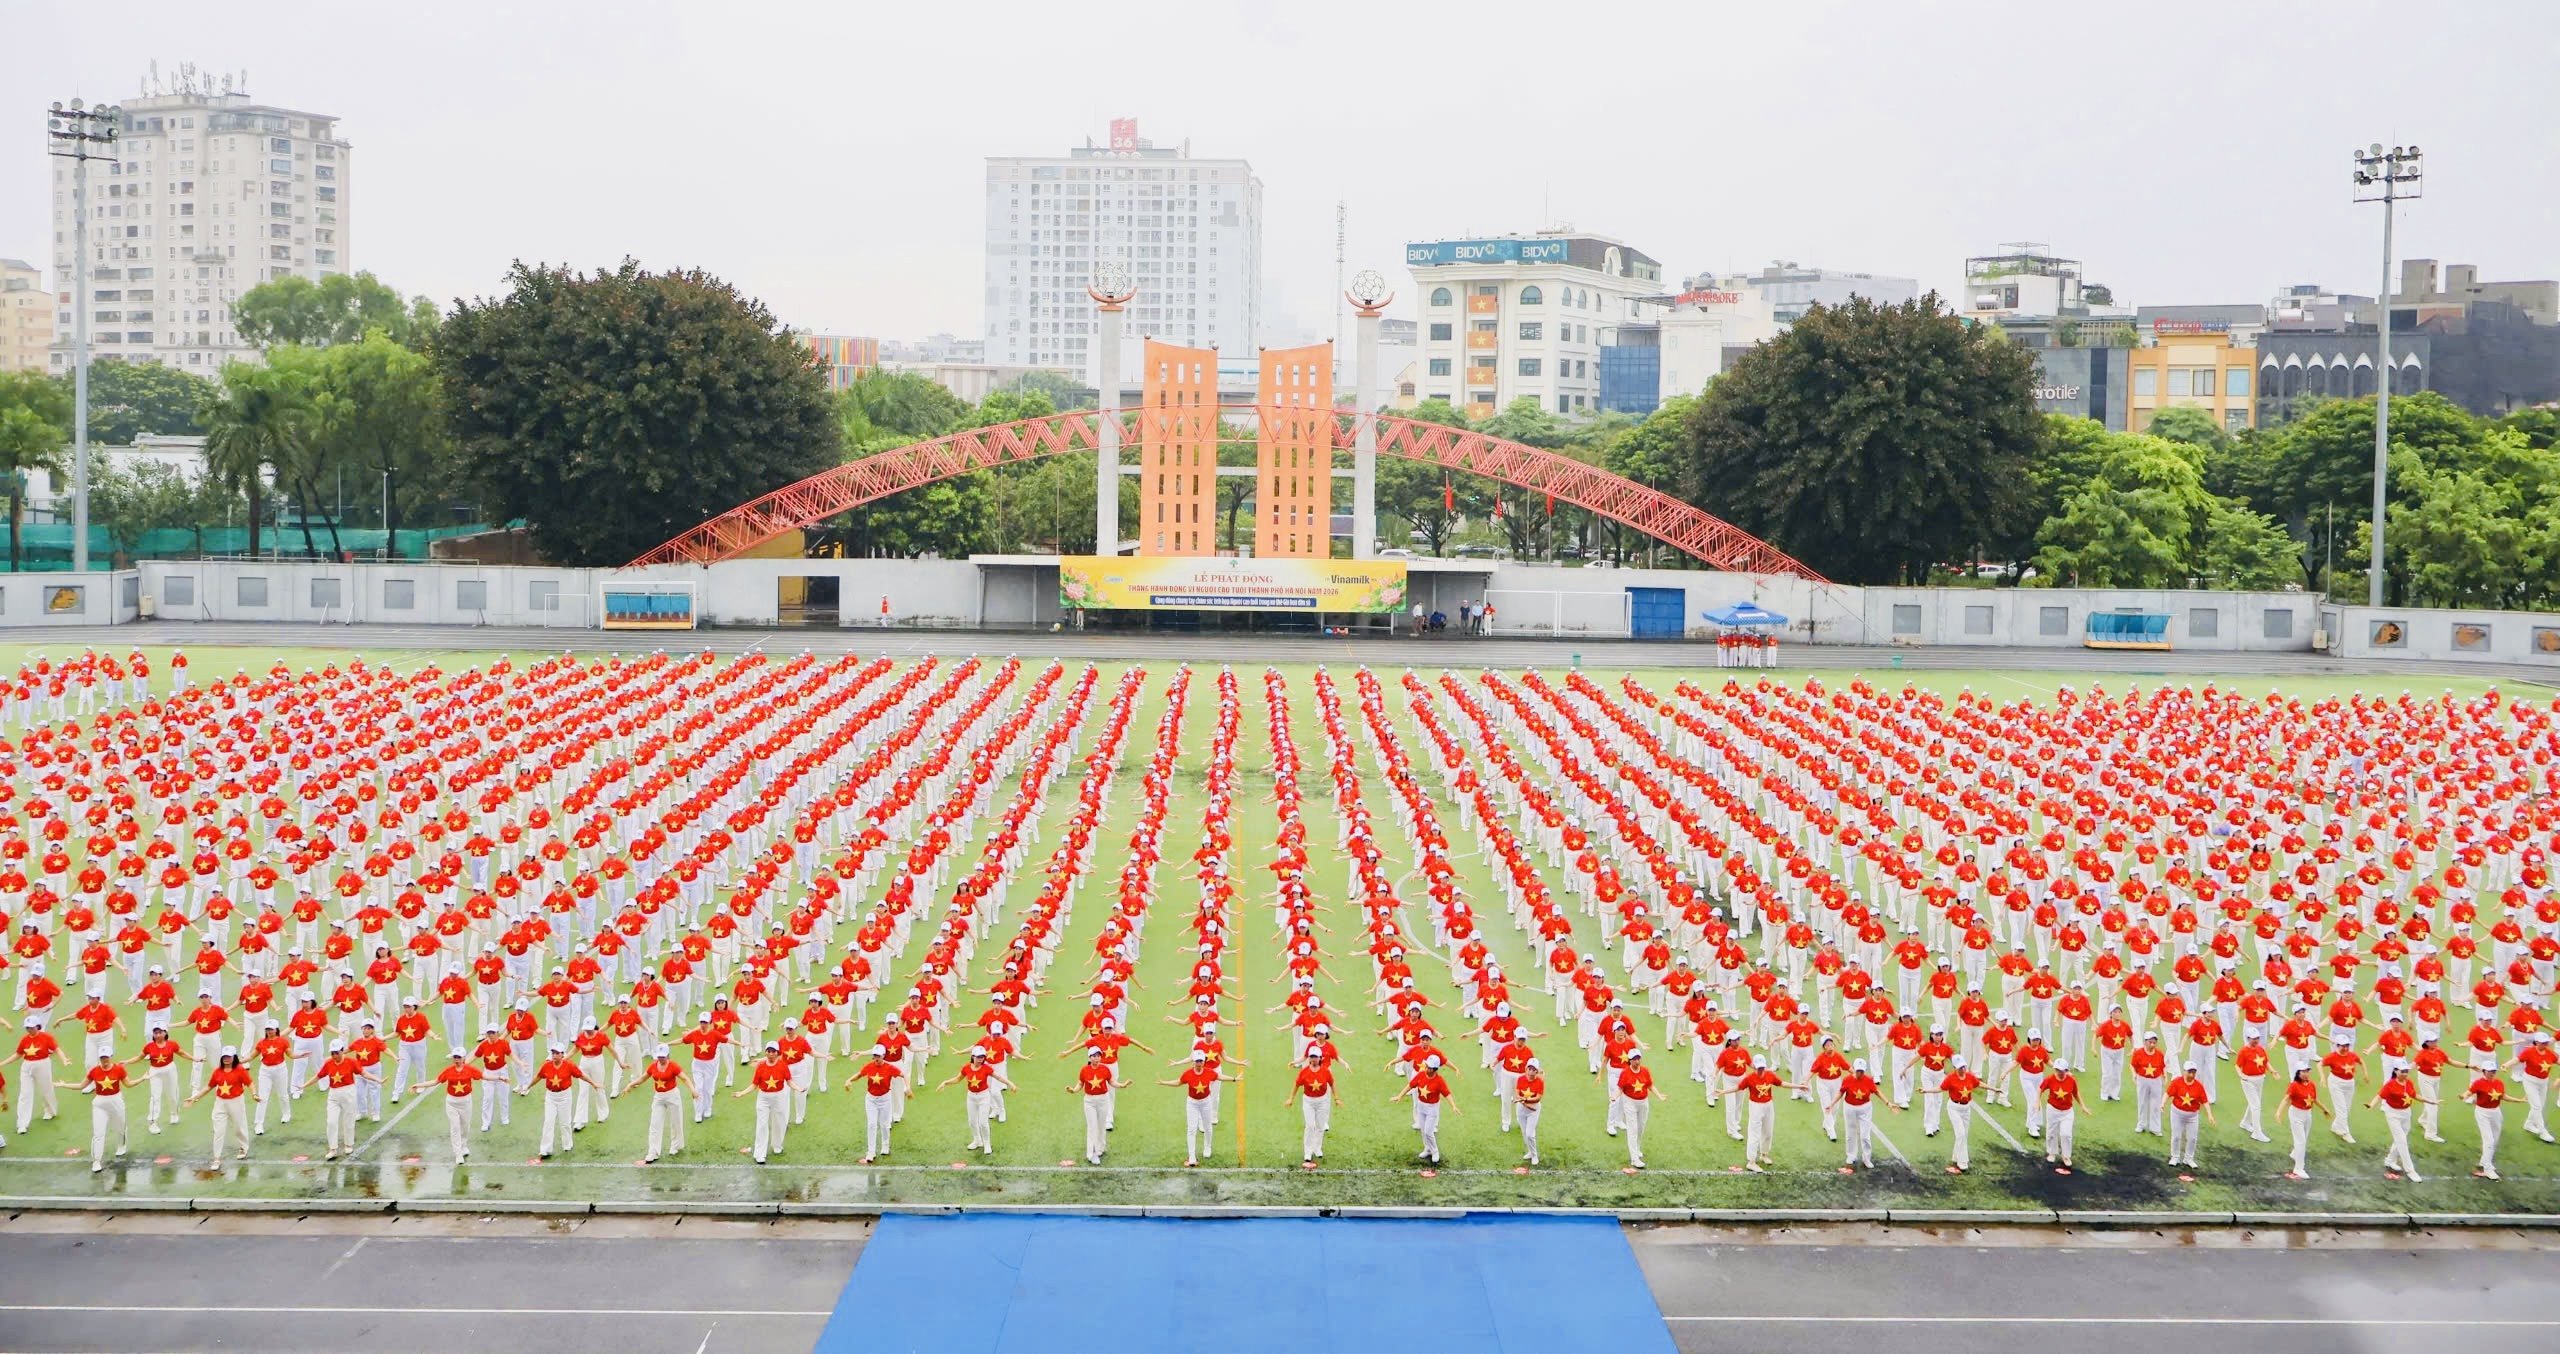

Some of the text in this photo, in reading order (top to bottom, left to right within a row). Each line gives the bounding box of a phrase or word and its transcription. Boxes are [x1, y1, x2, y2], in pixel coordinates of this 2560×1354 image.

[1113, 136, 1133, 148] 36
[242, 179, 257, 201] F
[1408, 249, 1434, 261] BIDV
[1455, 246, 1486, 259] BIDV
[1522, 246, 1551, 258] BIDV
[2031, 384, 2078, 400] urotile
[1331, 575, 1370, 584] Vinamilk
[1323, 588, 1339, 596] 2026
